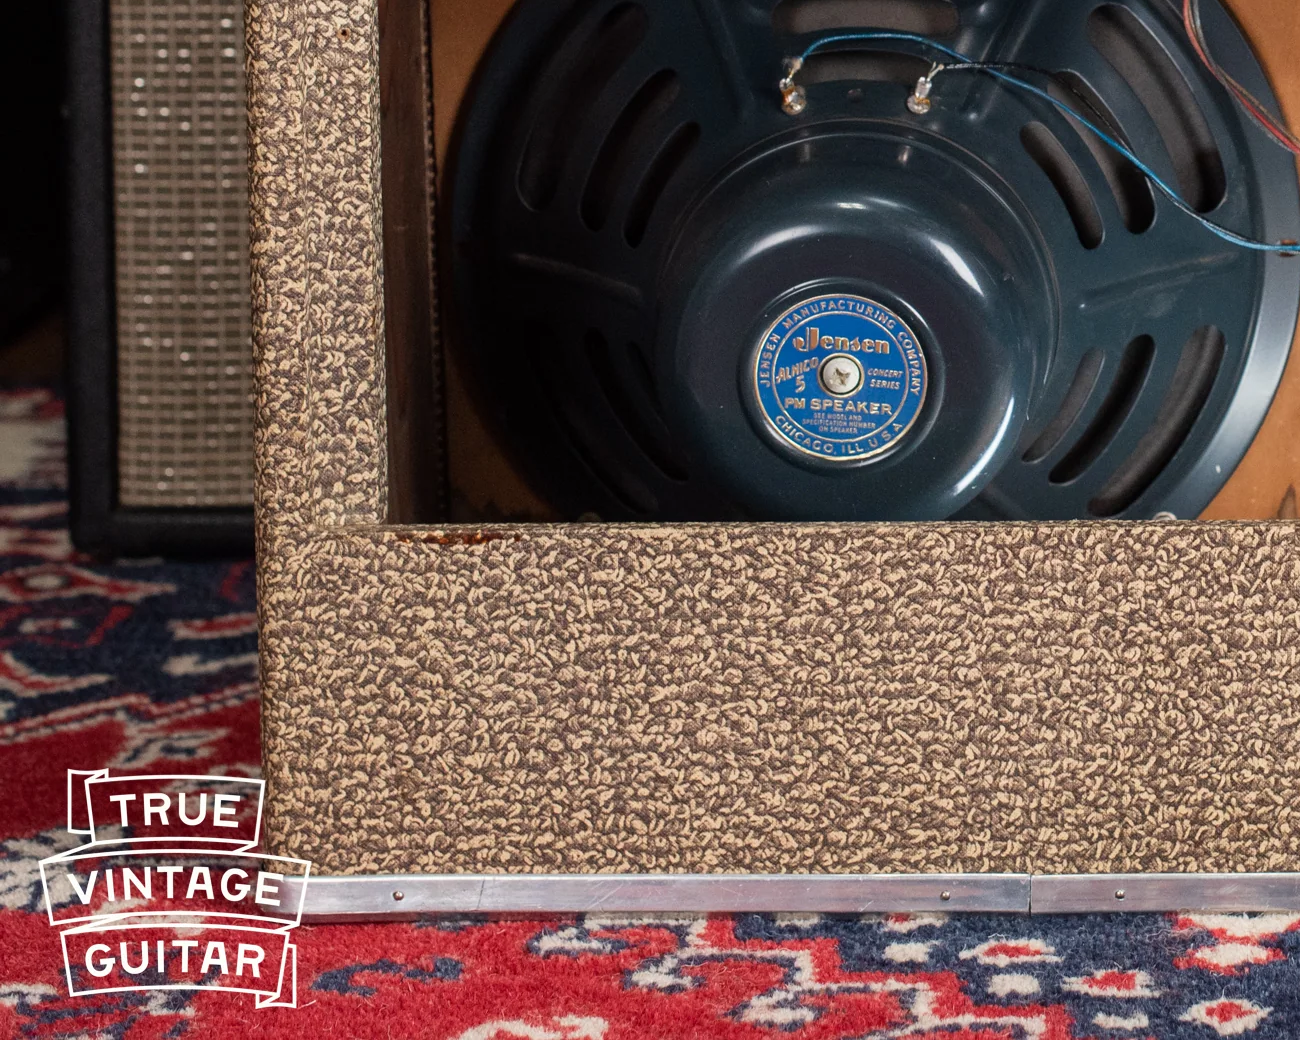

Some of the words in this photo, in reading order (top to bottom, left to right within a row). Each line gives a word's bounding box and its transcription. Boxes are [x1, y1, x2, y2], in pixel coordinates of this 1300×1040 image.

[760, 333, 781, 388] JENSEN
[782, 300, 897, 329] MANUFACTURING
[897, 332, 922, 396] COMPANY
[792, 327, 890, 355] Jensen
[776, 357, 819, 384] ALNICO
[867, 368, 903, 379] CONCERT
[795, 375, 806, 394] 5
[870, 379, 901, 390] SERIES
[784, 397, 806, 409] PM
[810, 398, 893, 415] SPEAKER
